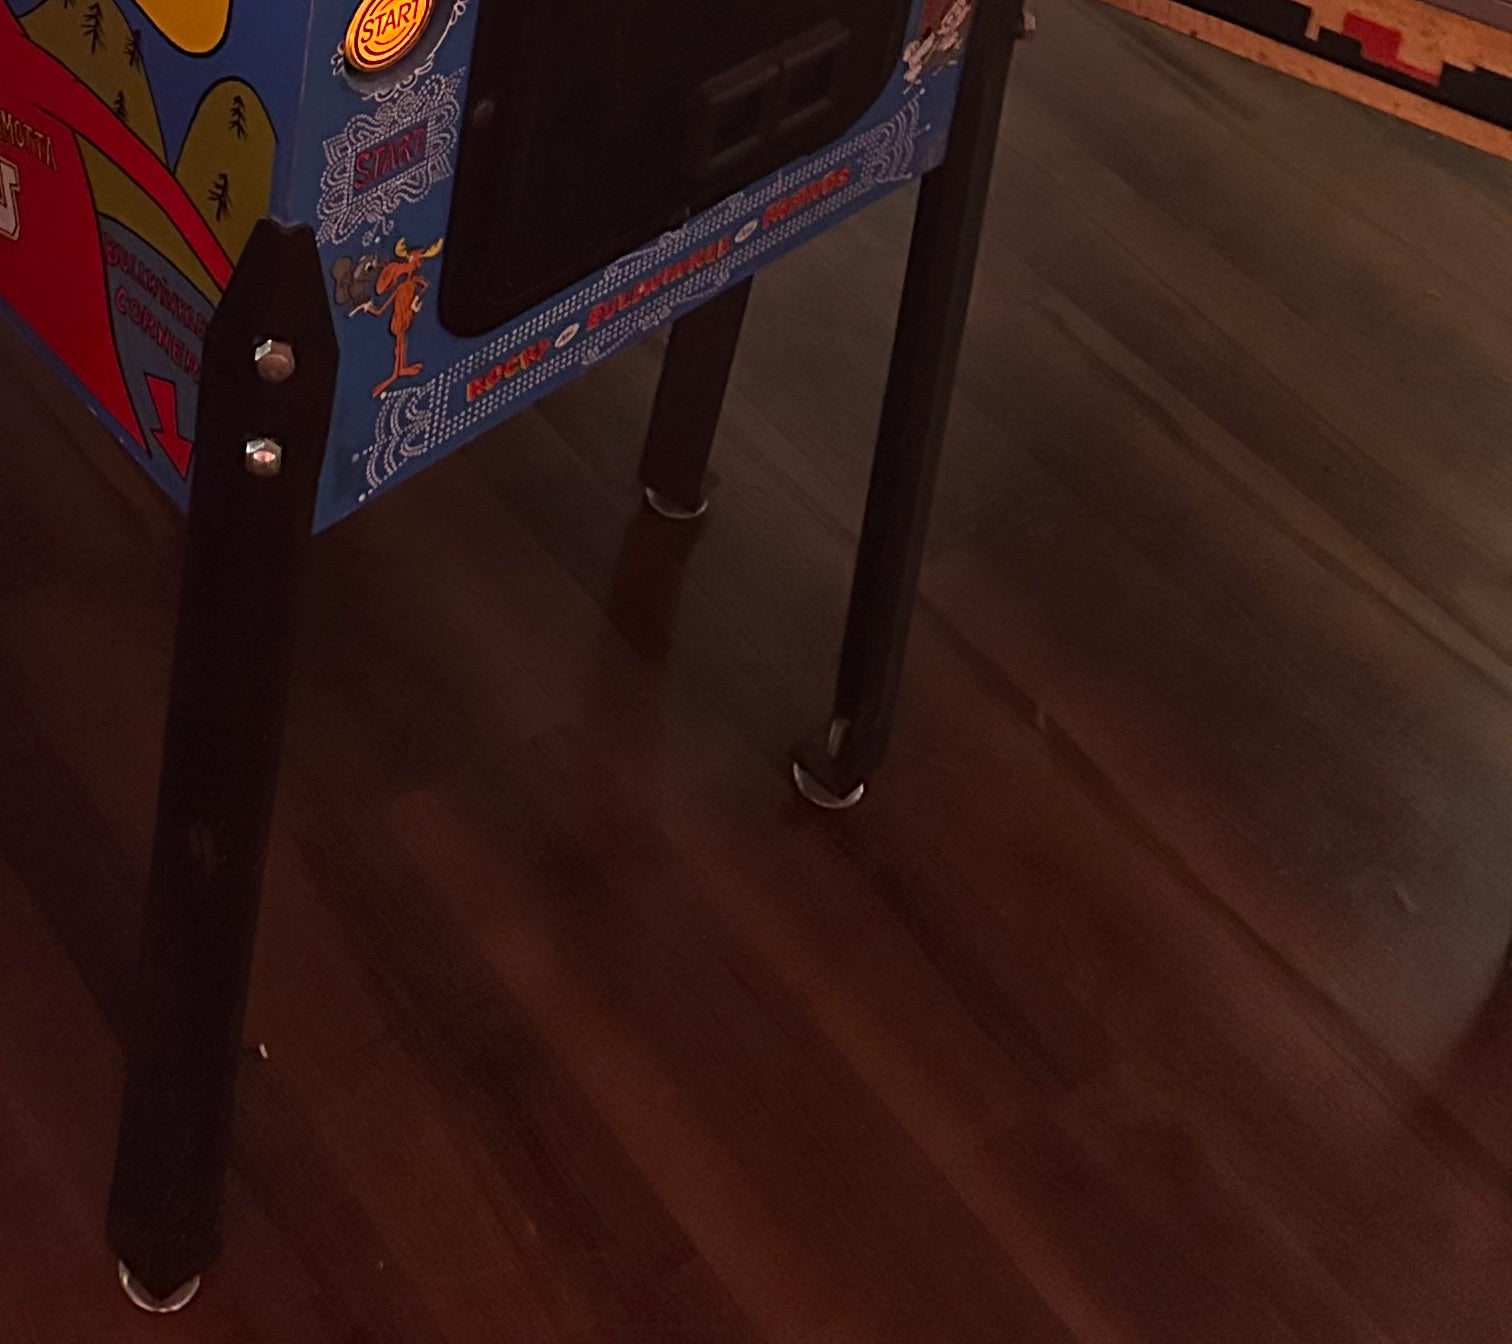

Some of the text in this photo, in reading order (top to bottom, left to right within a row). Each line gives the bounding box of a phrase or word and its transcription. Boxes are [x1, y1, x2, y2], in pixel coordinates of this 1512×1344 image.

[354, 125, 426, 189] START
[466, 165, 851, 401] ROCKY BULLWINKLE FRIENDS
[116, 286, 200, 379] CORNER
